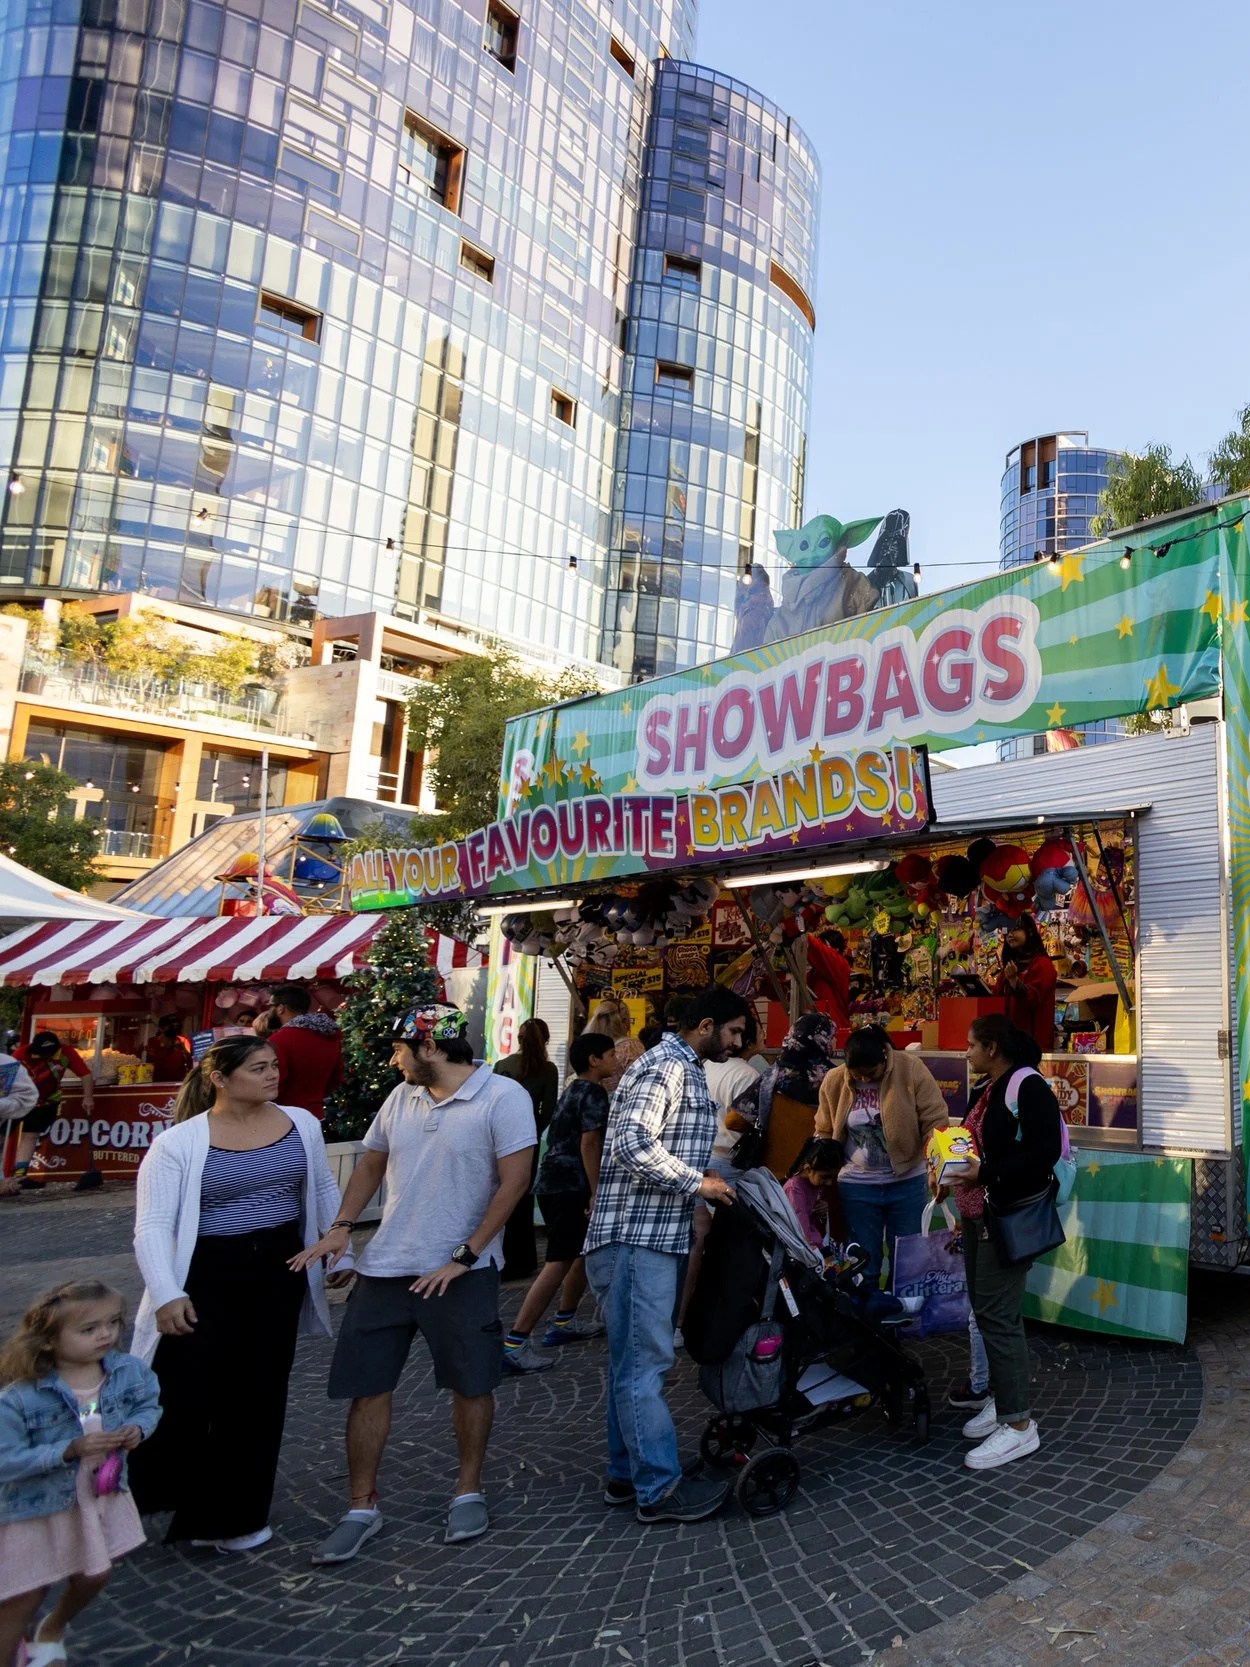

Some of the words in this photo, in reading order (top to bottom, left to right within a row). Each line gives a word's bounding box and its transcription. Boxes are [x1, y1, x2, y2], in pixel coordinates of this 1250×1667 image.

[643, 610, 1028, 780] SHOWBAGS
[351, 850, 390, 894] ALL
[388, 843, 459, 896] YOUR
[468, 793, 677, 887] FAVOURITE
[691, 743, 914, 851] BRANDS!
[614, 971, 648, 984] SPECIAL
[647, 974, 661, 984] $15
[92, 1150, 140, 1163] BUTTERED
